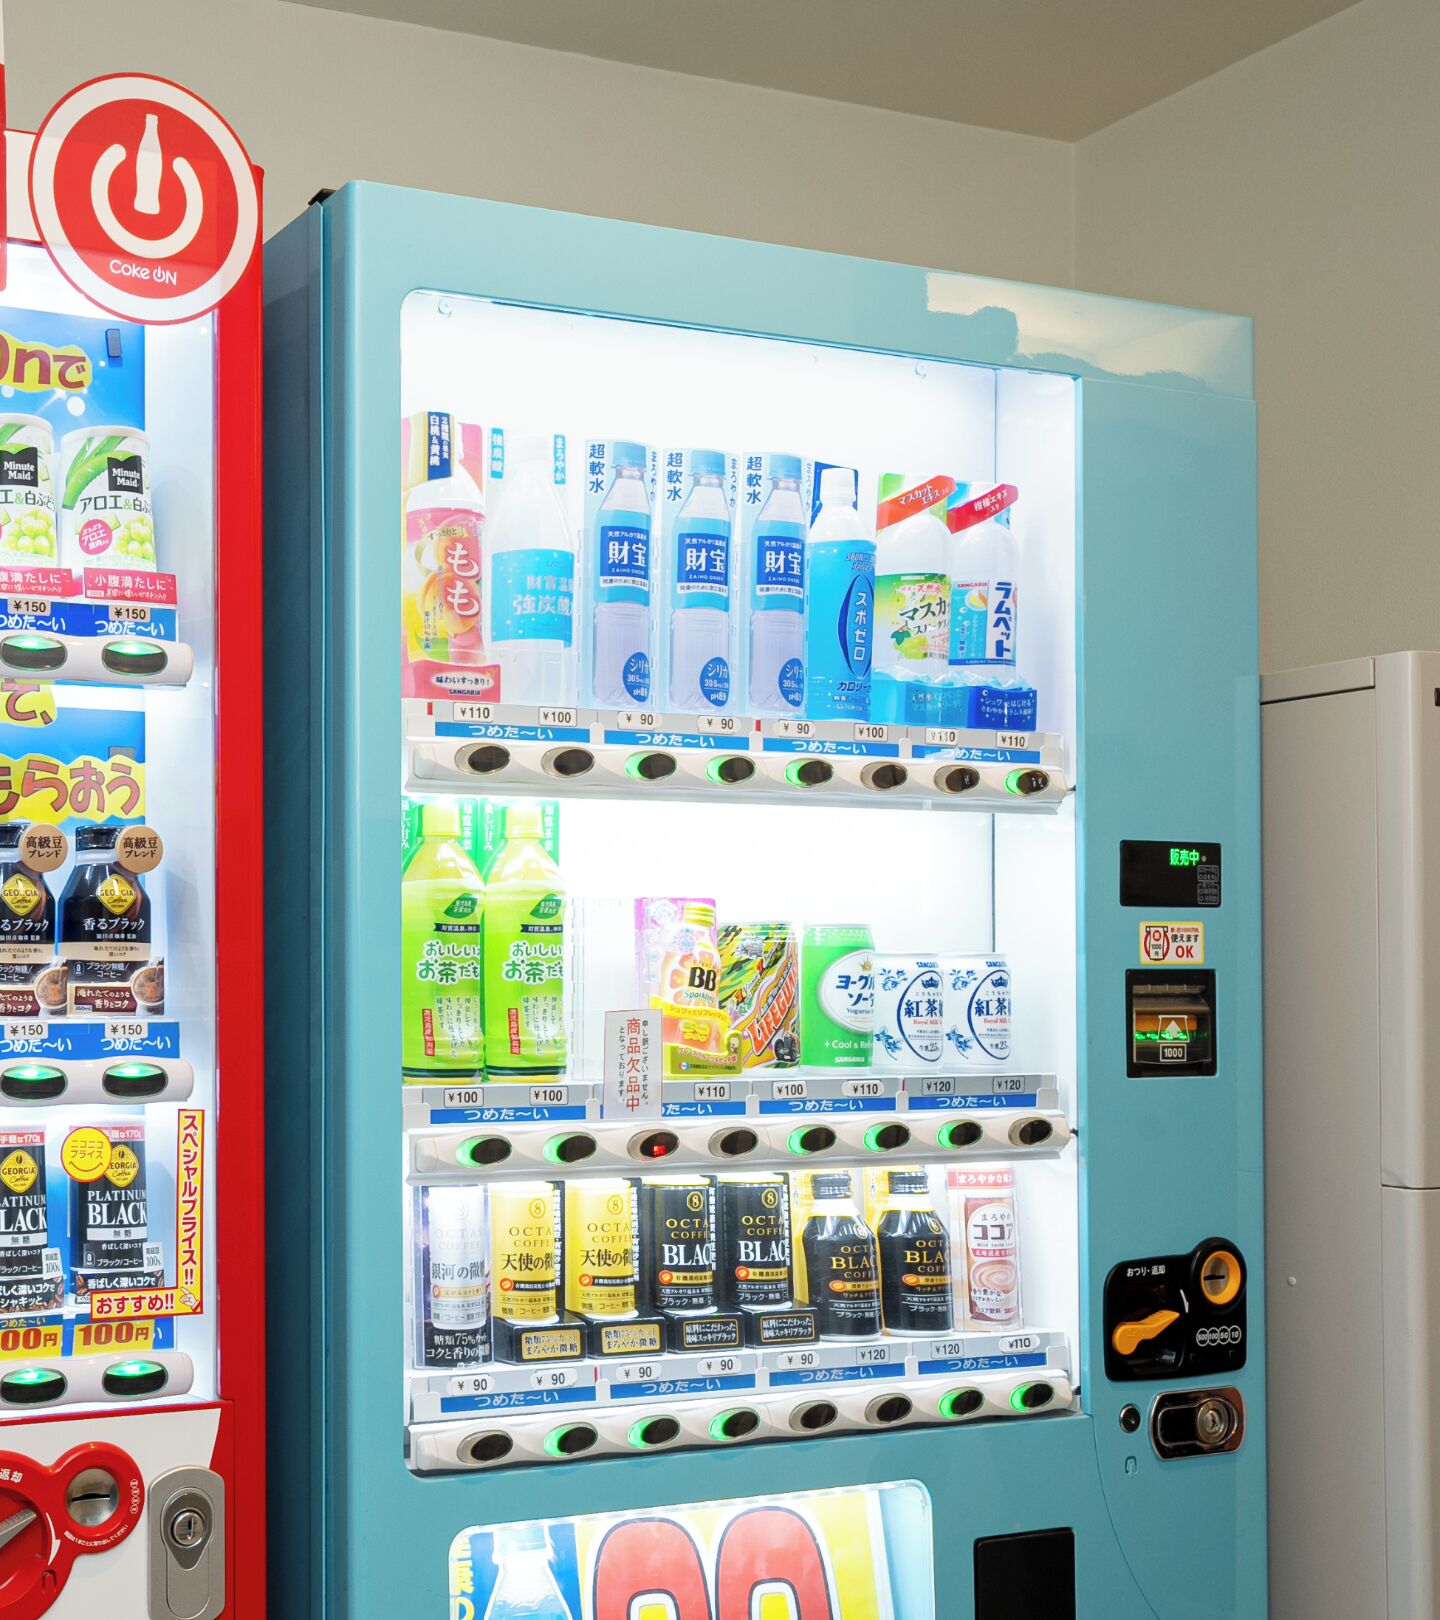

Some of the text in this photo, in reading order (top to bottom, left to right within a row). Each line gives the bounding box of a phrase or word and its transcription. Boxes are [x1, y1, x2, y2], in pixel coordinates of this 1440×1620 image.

[110, 259, 177, 286] Coke ON
[3, 461, 35, 472] Minute
[8, 471, 31, 480] Maid
[666, 452, 683, 501] 超軟水
[764, 551, 802, 576] 財宝
[446, 541, 480, 617] もも
[12, 599, 47, 612] ¥150
[113, 607, 146, 620] ¥150
[854, 591, 866, 662] スポゼロ
[542, 711, 571, 724] ¥100
[858, 727, 884, 739] ¥100
[1001, 736, 1025, 747] ¥110
[123, 837, 158, 849] 高級豆
[125, 850, 155, 858] ブレンド
[1170, 849, 1200, 866] 販売中
[83, 918, 145, 931] 香るブラック
[97, 971, 122, 979] コーヒー
[689, 966, 717, 992] BB
[109, 1023, 143, 1036] ¥150
[832, 1039, 852, 1049] Cool
[1164, 1048, 1183, 1058] 1000
[626, 1017, 640, 1112] 商品欠品中
[852, 1083, 878, 1095] ¥110
[997, 1080, 1021, 1090] ¥120
[448, 1091, 478, 1103] ¥100
[698, 1086, 725, 1098] ¥110
[11, 1235, 31, 1244] 無糖
[77, 1321, 150, 1346] 100円
[935, 1344, 960, 1355] ¥120
